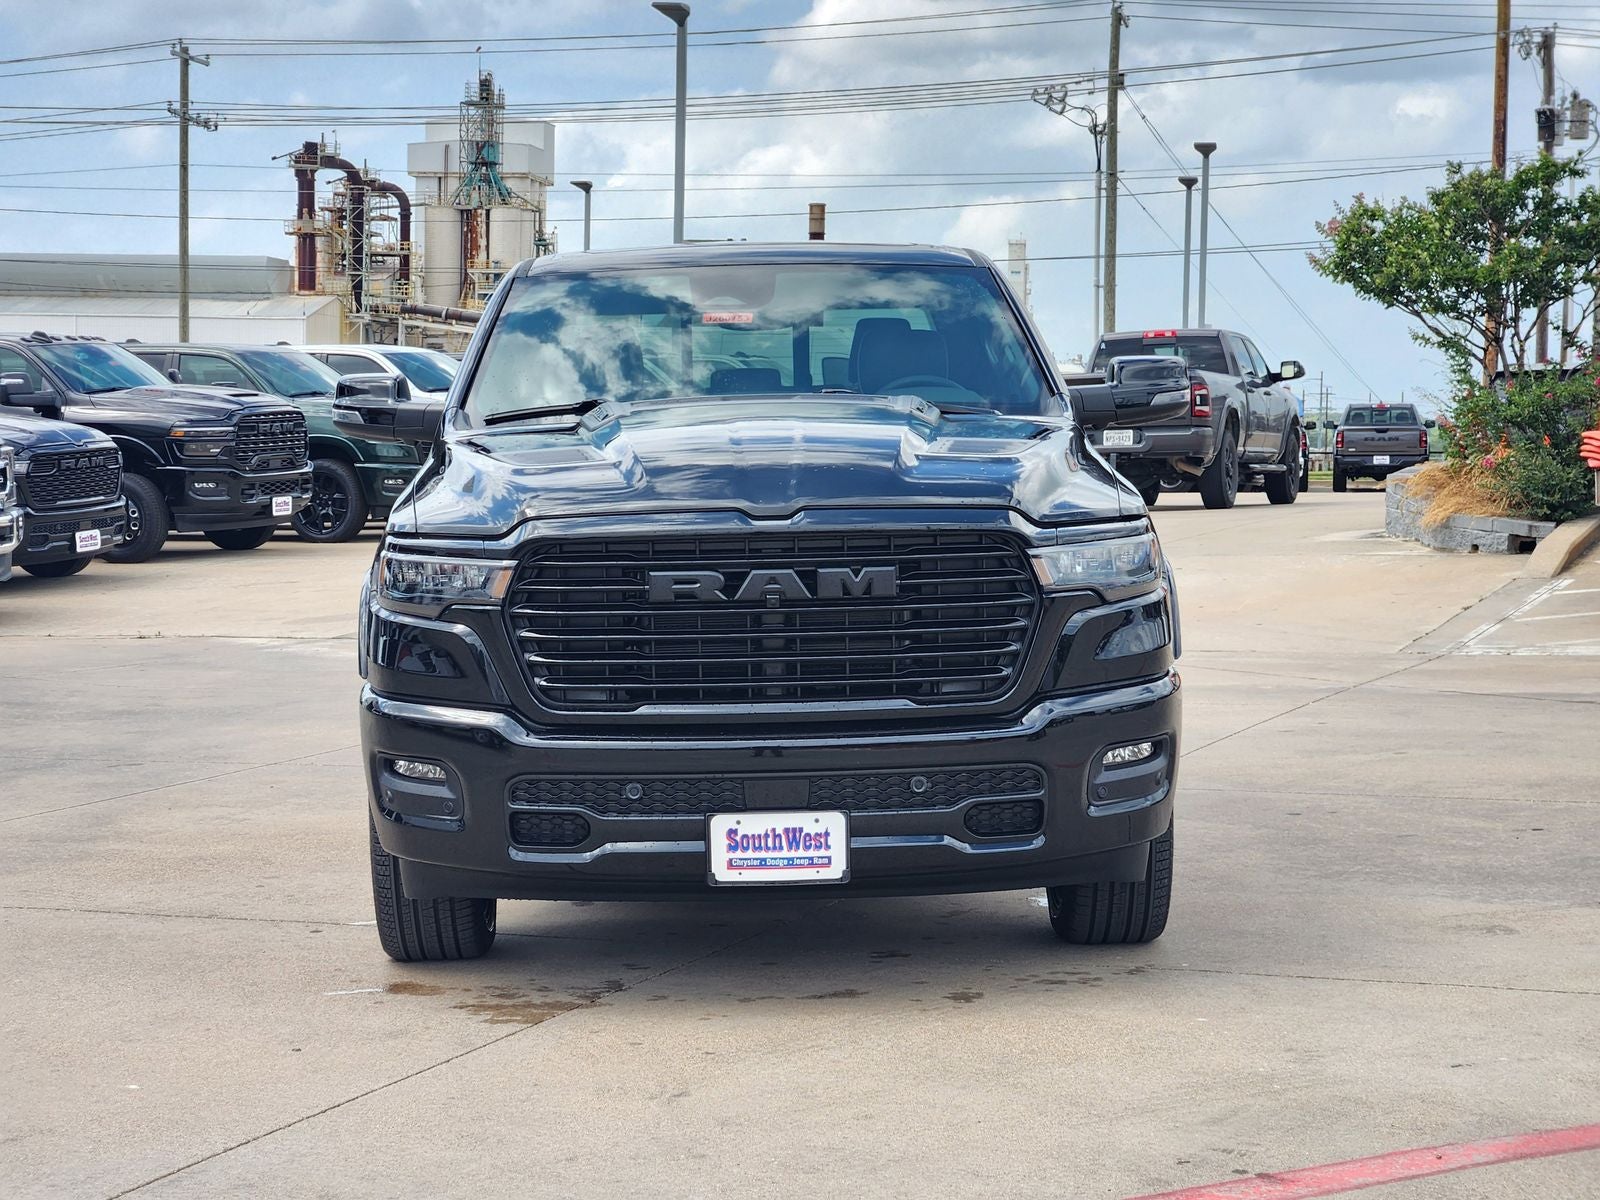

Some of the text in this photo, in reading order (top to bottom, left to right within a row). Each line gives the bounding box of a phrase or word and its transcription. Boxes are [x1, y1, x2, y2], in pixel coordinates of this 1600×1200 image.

[258, 423, 295, 433] RAM
[60, 457, 104, 469] RAM
[649, 566, 897, 601] RAM
[726, 826, 832, 853] SouthWest
[731, 857, 829, 867] Chrysler Dodge Jeep Ram
